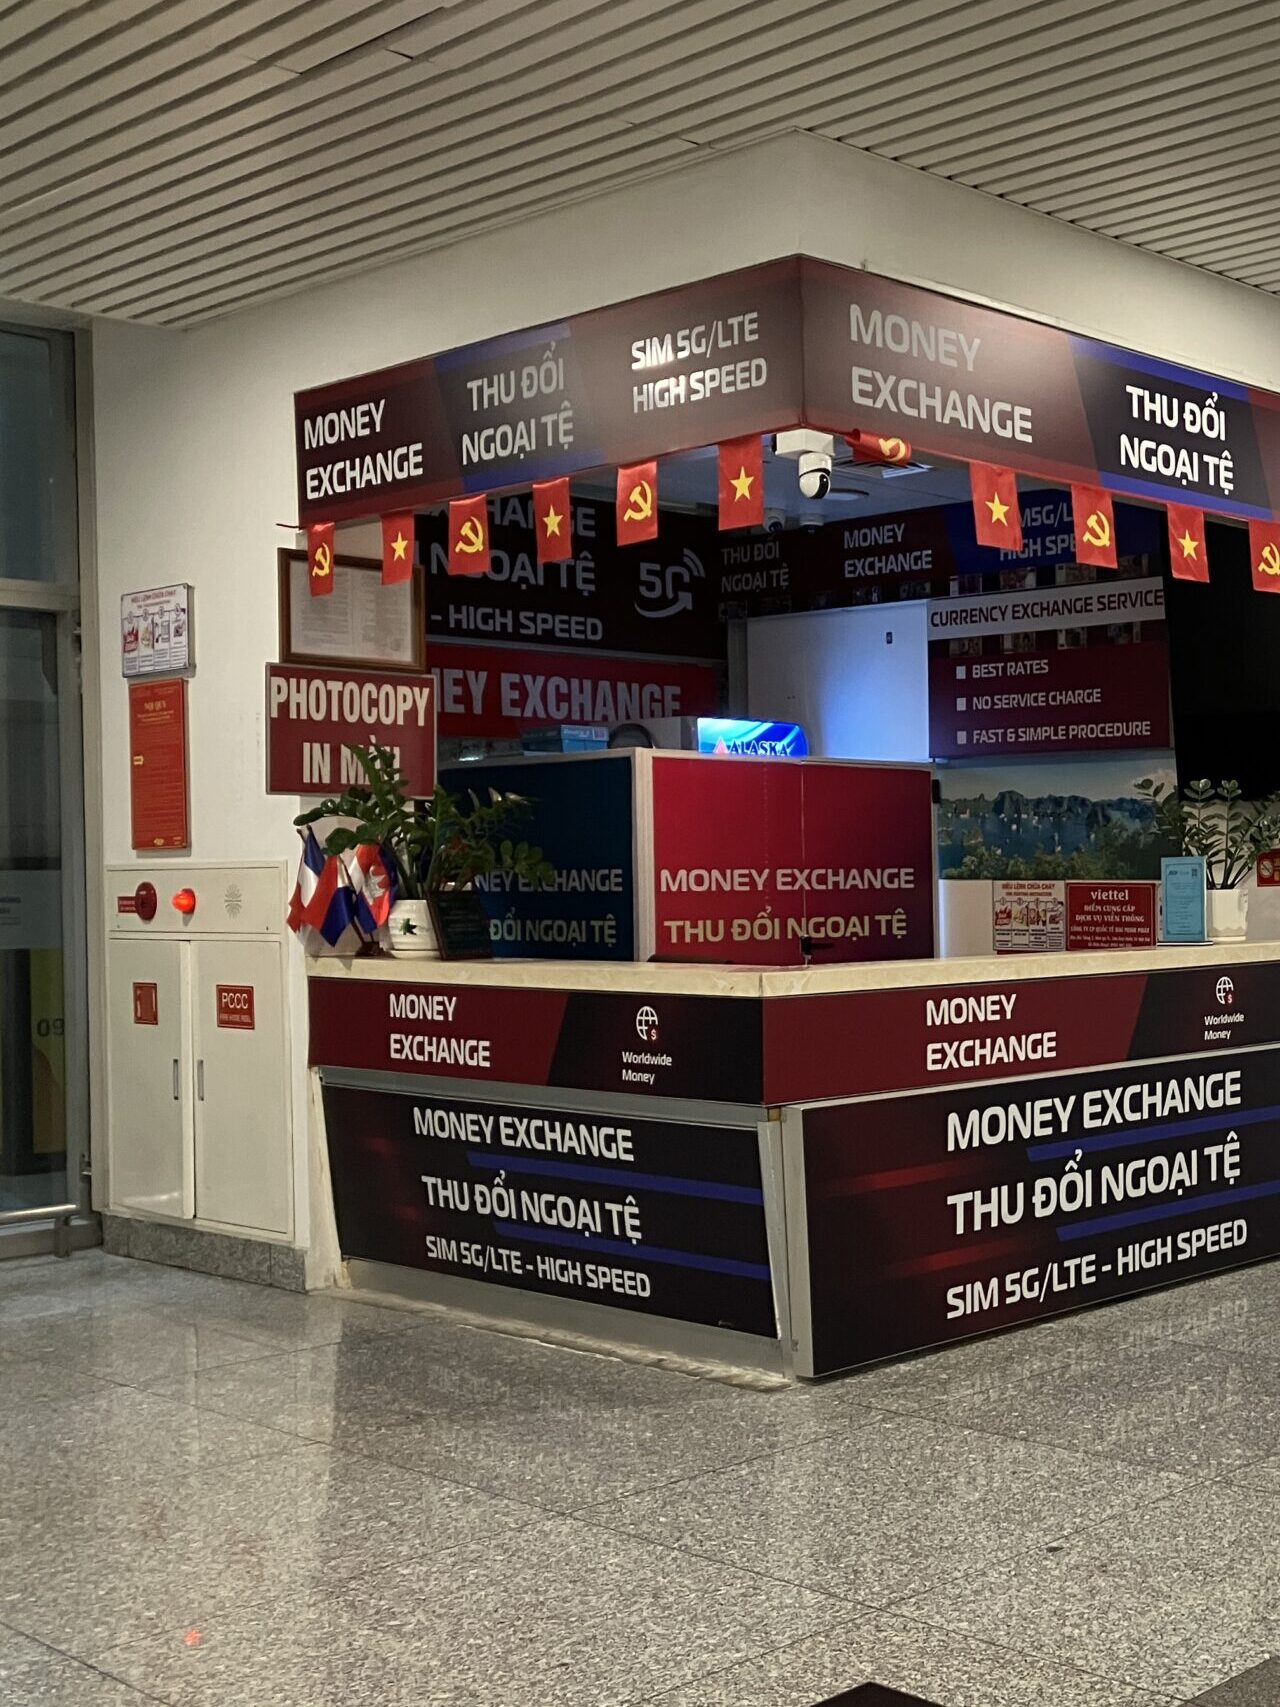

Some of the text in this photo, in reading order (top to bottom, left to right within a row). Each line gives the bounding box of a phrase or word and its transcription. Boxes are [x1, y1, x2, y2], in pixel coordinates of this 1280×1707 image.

[631, 312, 760, 371] SIM 5G/LTE
[849, 304, 981, 372] MONEY
[466, 341, 565, 411] THU ĐỔI
[632, 357, 767, 414] HIGH SPEED
[304, 399, 386, 450] MONEY
[851, 366, 1033, 444] EXCHANGE
[1126, 384, 1227, 441] THU ĐỔI
[461, 401, 574, 467] NGOẠI TỆ
[305, 443, 424, 499] EXCHANGE
[1119, 433, 1235, 495] NGOẠI TỆ
[844, 523, 905, 549] MONEY
[1045, 533, 1076, 556] SPE
[430, 543, 545, 590] NOẠI
[721, 548, 750, 565] THU
[844, 550, 933, 578] EXCHANGE
[721, 562, 790, 594] NGOẠI TỆ
[449, 604, 513, 633] HIGH
[519, 611, 603, 640] SPEED
[930, 589, 1164, 628] CURRENCY EXCHANGE SERVICE
[972, 659, 1049, 678] BEST RATES
[270, 676, 430, 727] PHOTOCOPY
[500, 672, 681, 722] EXCHANGE
[973, 688, 1101, 710] NO SERVICE CHARGE
[730, 739, 790, 757] ALASKA
[973, 728, 1004, 744] FAST
[1017, 726, 1066, 742] SIMPLE
[1069, 721, 1151, 740] PROCEDURE
[303, 741, 331, 784] IN
[474, 868, 623, 892] NEY EHANGE
[660, 868, 915, 892] MONEY EXCHANGE
[1090, 889, 1129, 901] viettel
[489, 907, 617, 947] ĐỔI NGOẠI TỆ
[664, 905, 907, 943] THU ĐỔI NGOẠI TỆ
[221, 992, 249, 1009] PCCC
[388, 993, 457, 1022] MONEY
[926, 994, 1016, 1026] MONEY
[1204, 1012, 1245, 1026] Worldwide
[389, 1032, 491, 1068] EXCHANGE
[926, 1031, 1057, 1071] EXCHANGE
[1204, 1029, 1231, 1041] Money
[622, 1051, 673, 1067] Worldwide
[622, 1069, 655, 1085] Money
[947, 1071, 1242, 1152] MONEY EXCHANGE
[413, 1105, 635, 1161] MONEY EXCHANGE
[947, 1131, 1241, 1235] THU ĐỔI NGOẠI TỆ
[421, 1170, 642, 1245] THU ĐỔI NGOẠI TỆ
[426, 1235, 458, 1262] SIM
[460, 1243, 523, 1275] 5G/LTE
[537, 1255, 582, 1287] HIGH
[585, 1263, 651, 1298] SPEED
[946, 1277, 999, 1320] SIM
[1005, 1254, 1096, 1303] 5G/LTE
[1117, 1235, 1172, 1275] HIGH
[1177, 1219, 1247, 1262] SPEED
